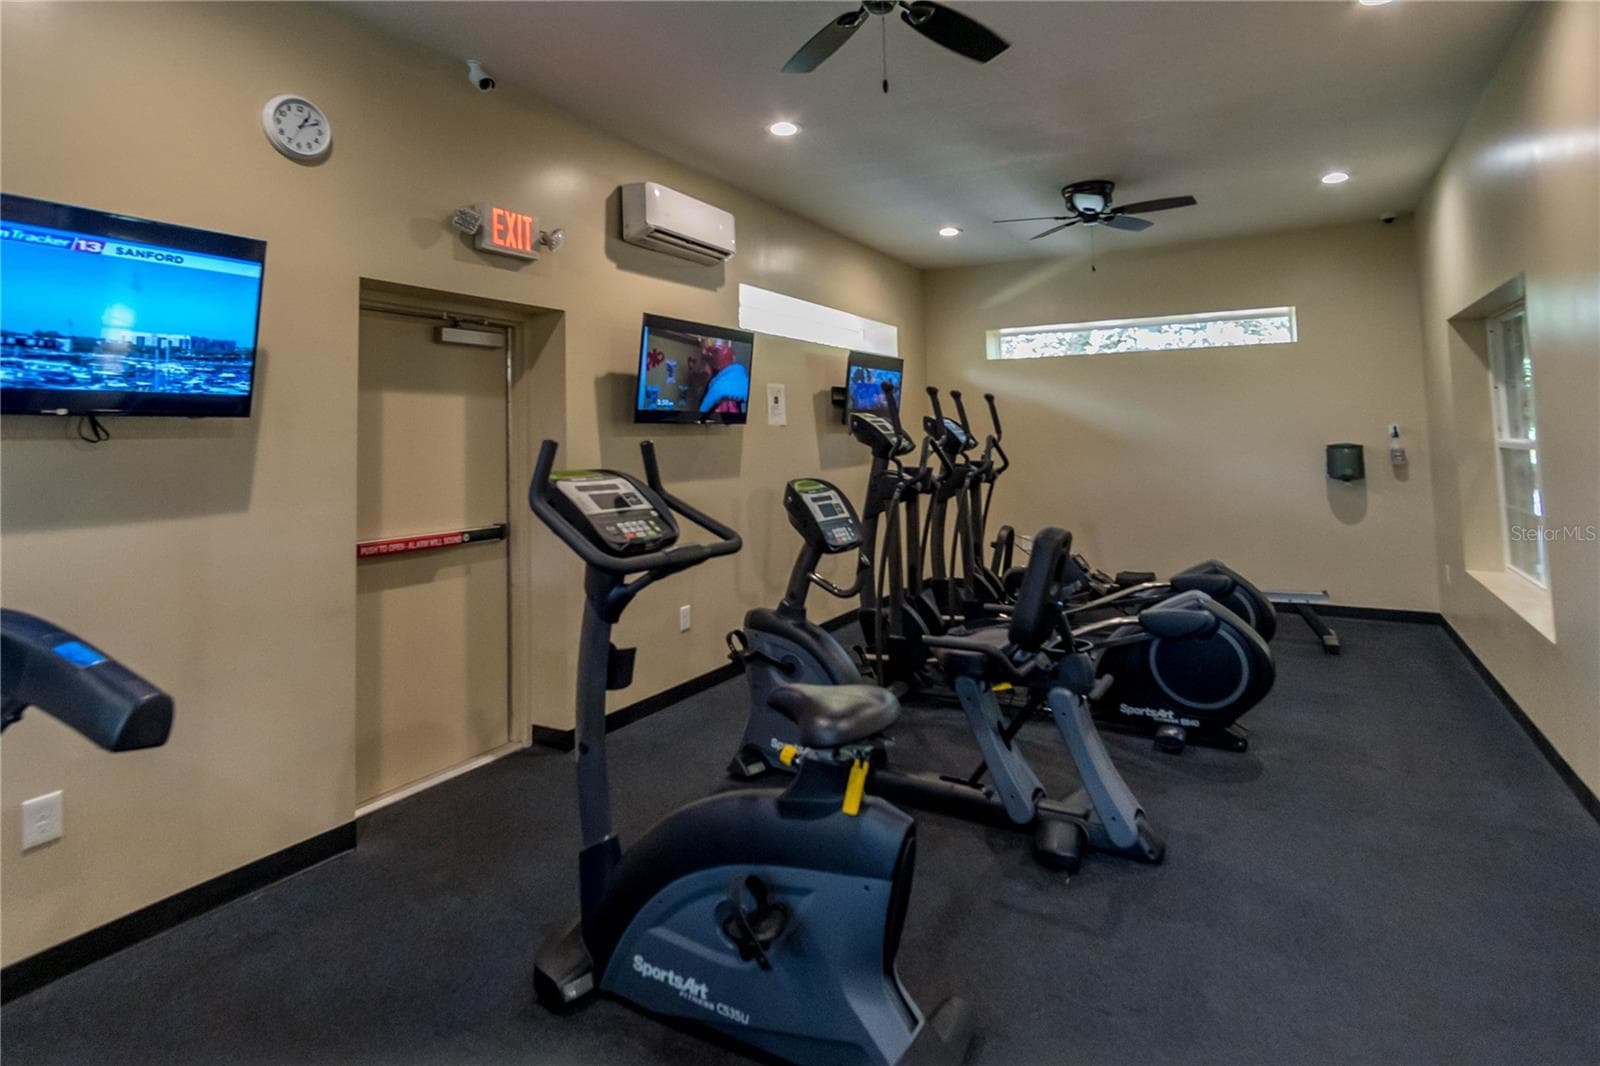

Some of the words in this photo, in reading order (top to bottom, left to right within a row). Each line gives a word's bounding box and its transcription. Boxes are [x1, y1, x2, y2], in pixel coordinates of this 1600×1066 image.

[492, 207, 534, 252] EXIT
[11, 229, 71, 247] Tracker
[77, 239, 103, 253] 13
[115, 246, 184, 265] SANFORD
[379, 544, 388, 553] TO
[430, 538, 443, 547] WILL
[1120, 703, 1174, 719] SportsArt
[632, 954, 709, 1000] SportsArt
